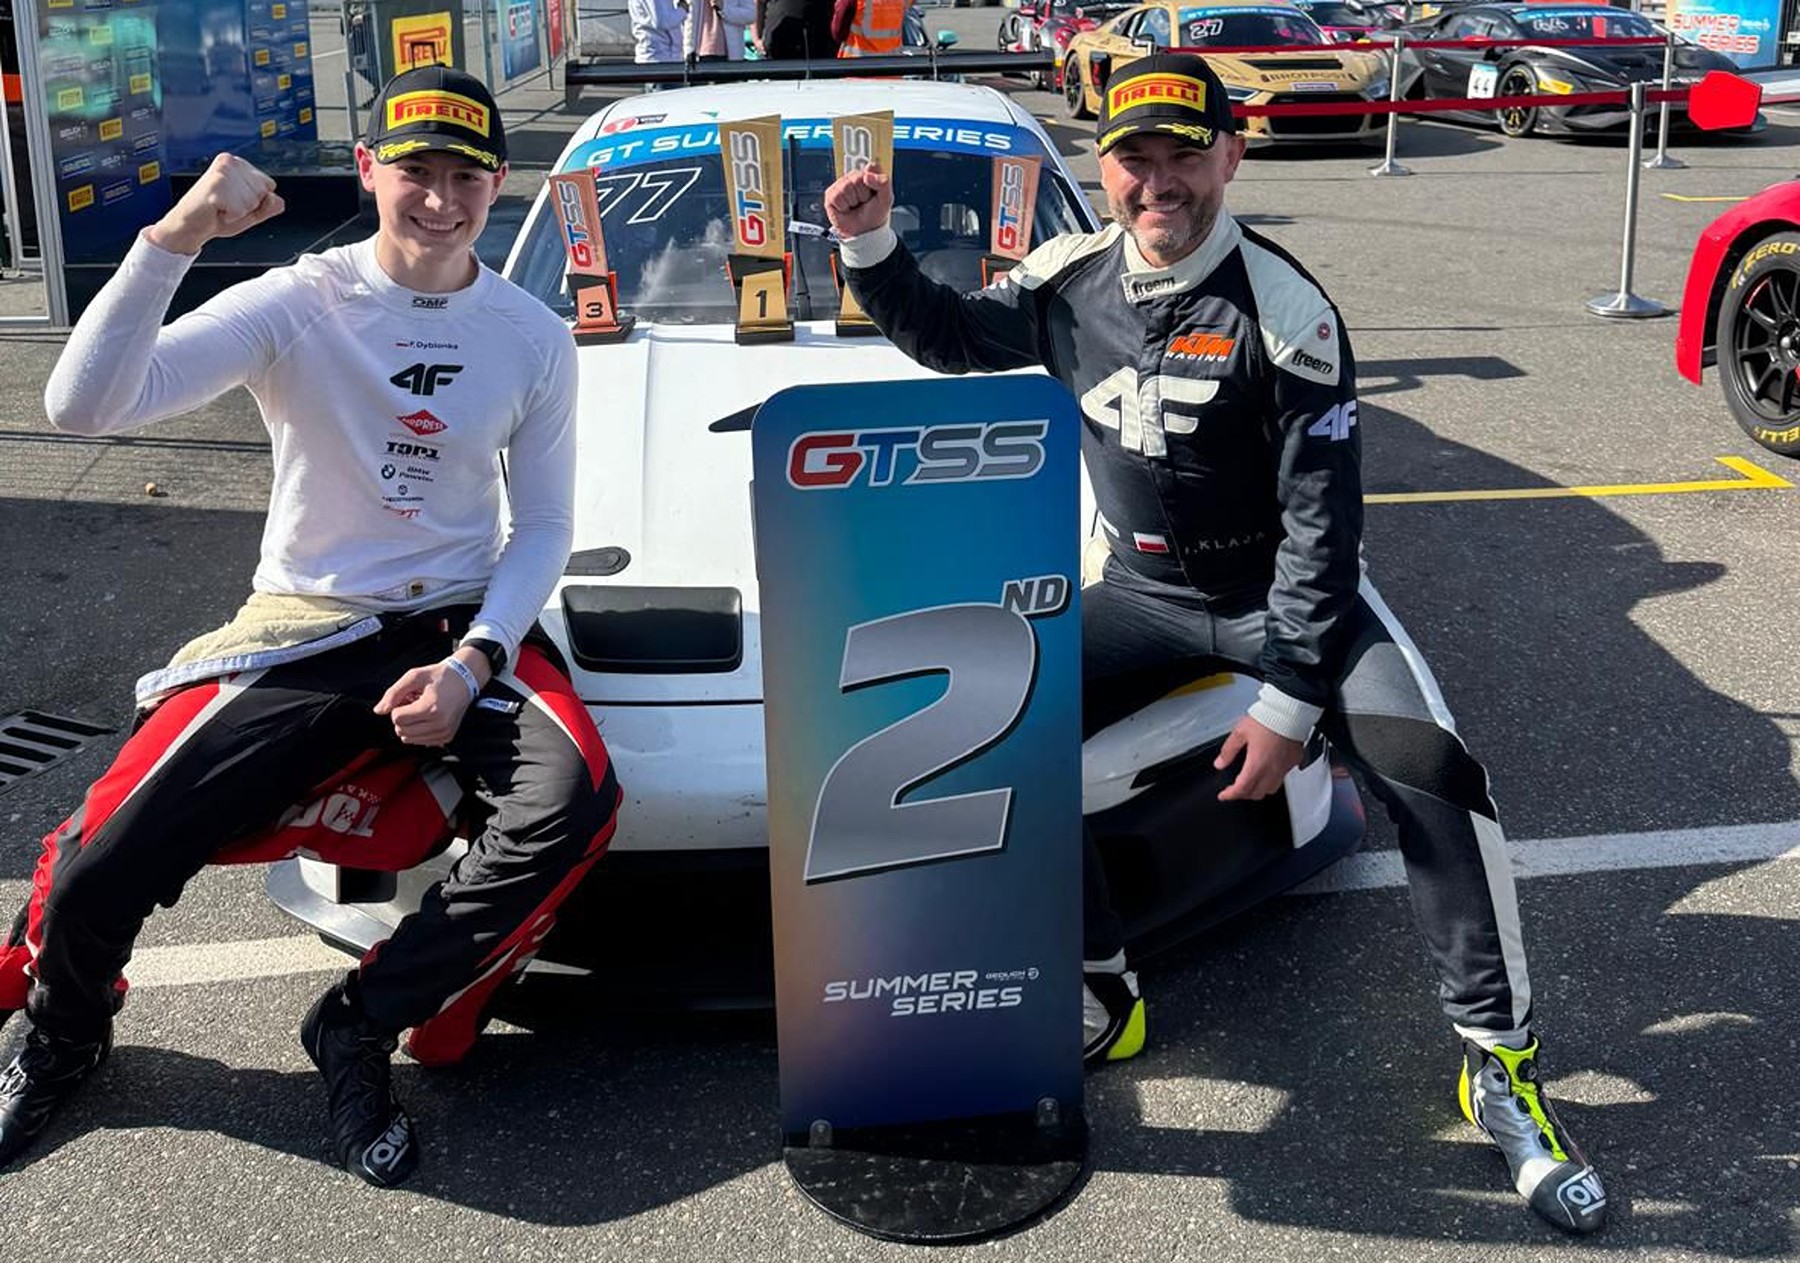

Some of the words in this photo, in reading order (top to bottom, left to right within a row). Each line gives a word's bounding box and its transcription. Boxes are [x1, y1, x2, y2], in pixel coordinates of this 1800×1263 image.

[1189, 19, 1224, 40] 27
[1672, 12, 1740, 31] SUMMER
[399, 26, 448, 65] PIRELI
[1114, 78, 1200, 110] PIRELLI
[395, 96, 484, 129] PIRELLI
[586, 141, 644, 168] GT
[892, 126, 1012, 150] ERIES
[729, 130, 767, 248] GTSS
[997, 163, 1024, 251] GTSS
[556, 181, 594, 269] GTSS
[1131, 275, 1176, 298] freem
[585, 301, 604, 318] 3
[753, 289, 768, 318] 1
[1165, 351, 1228, 363] RACING
[1167, 333, 1236, 357] KTM
[389, 362, 465, 396] 4F
[1292, 349, 1334, 376] freem
[1080, 366, 1220, 457] 4F
[1760, 426, 1800, 444] ELLI
[786, 419, 1049, 491] GTSS
[804, 602, 1037, 885] 2
[1000, 573, 1070, 619] ND
[823, 969, 978, 1003] SUMMER
[890, 987, 1023, 1017] SERIES
[1566, 1172, 1607, 1207] OM
